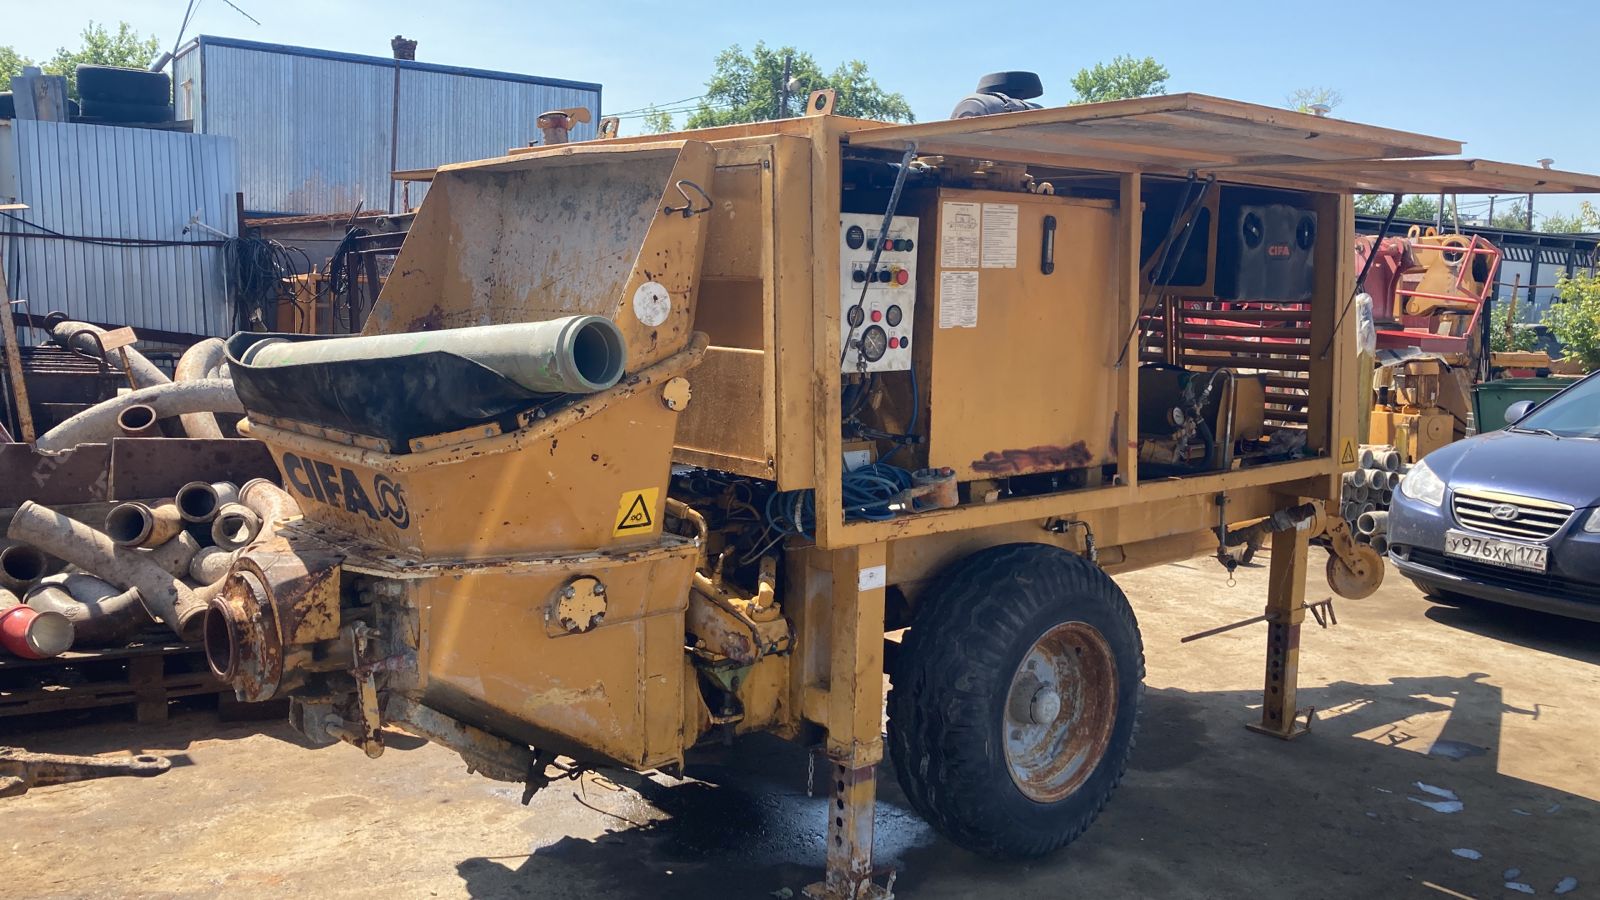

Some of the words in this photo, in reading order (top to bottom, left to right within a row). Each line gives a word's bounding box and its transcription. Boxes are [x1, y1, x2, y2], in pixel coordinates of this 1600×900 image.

[1268, 245, 1290, 257] CIFA
[282, 452, 381, 521] CIFA
[1517, 546, 1541, 563] 177
